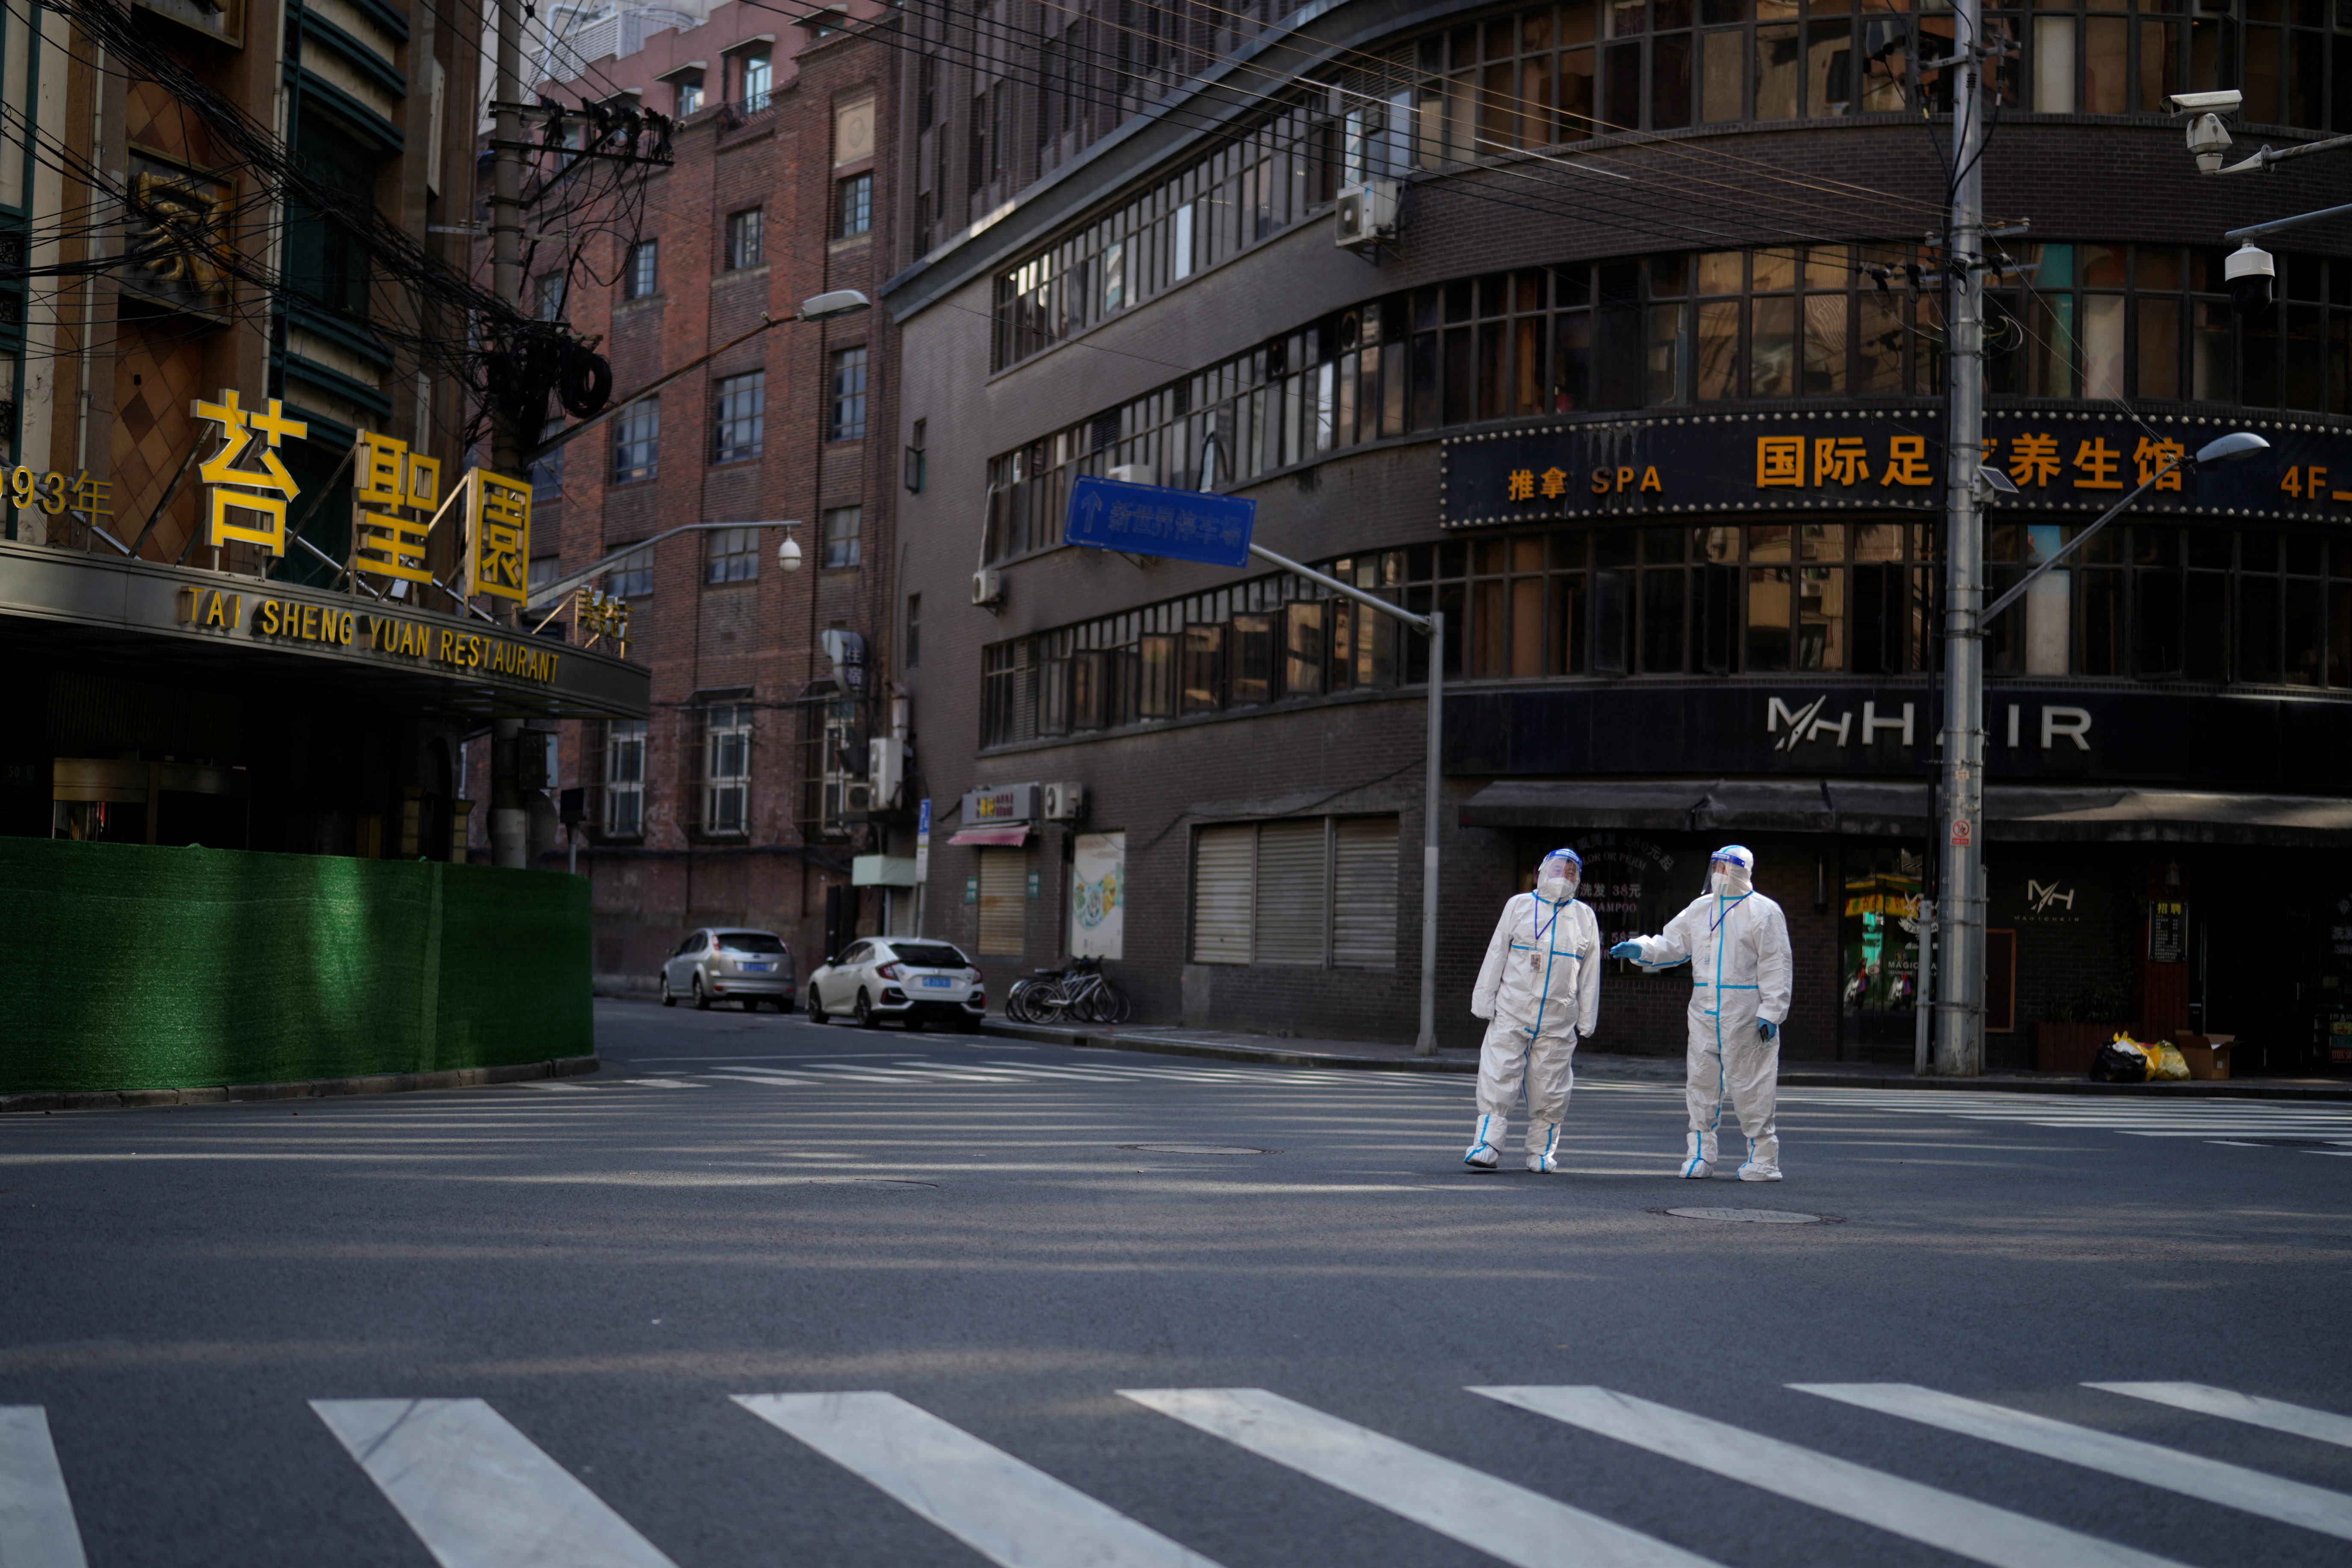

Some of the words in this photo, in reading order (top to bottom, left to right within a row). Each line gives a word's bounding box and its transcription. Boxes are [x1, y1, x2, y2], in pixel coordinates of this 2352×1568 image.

[0, 467, 115, 526] 93年
[191, 388, 532, 608] 苔聖園
[1508, 466, 1568, 501] 推拿
[1591, 466, 1663, 494] SPA
[1107, 499, 1243, 548] 新世界停车场
[188, 587, 242, 629] TAI
[262, 599, 355, 645] SHENG
[369, 616, 431, 657] YUAN
[440, 629, 560, 683] RESTAURANT
[845, 645, 863, 685] 住宿
[1862, 699, 2093, 751] HIR
[8, 765, 20, 778] 50
[1603, 851, 1617, 861] OR
[1619, 853, 1647, 871] PERM
[1579, 883, 1607, 898] 洗发
[1612, 883, 1642, 898] 38元
[1590, 902, 1638, 913] HAMPOO
[2157, 901, 2182, 915] 招聘
[1887, 960, 1937, 969] MAGICA
